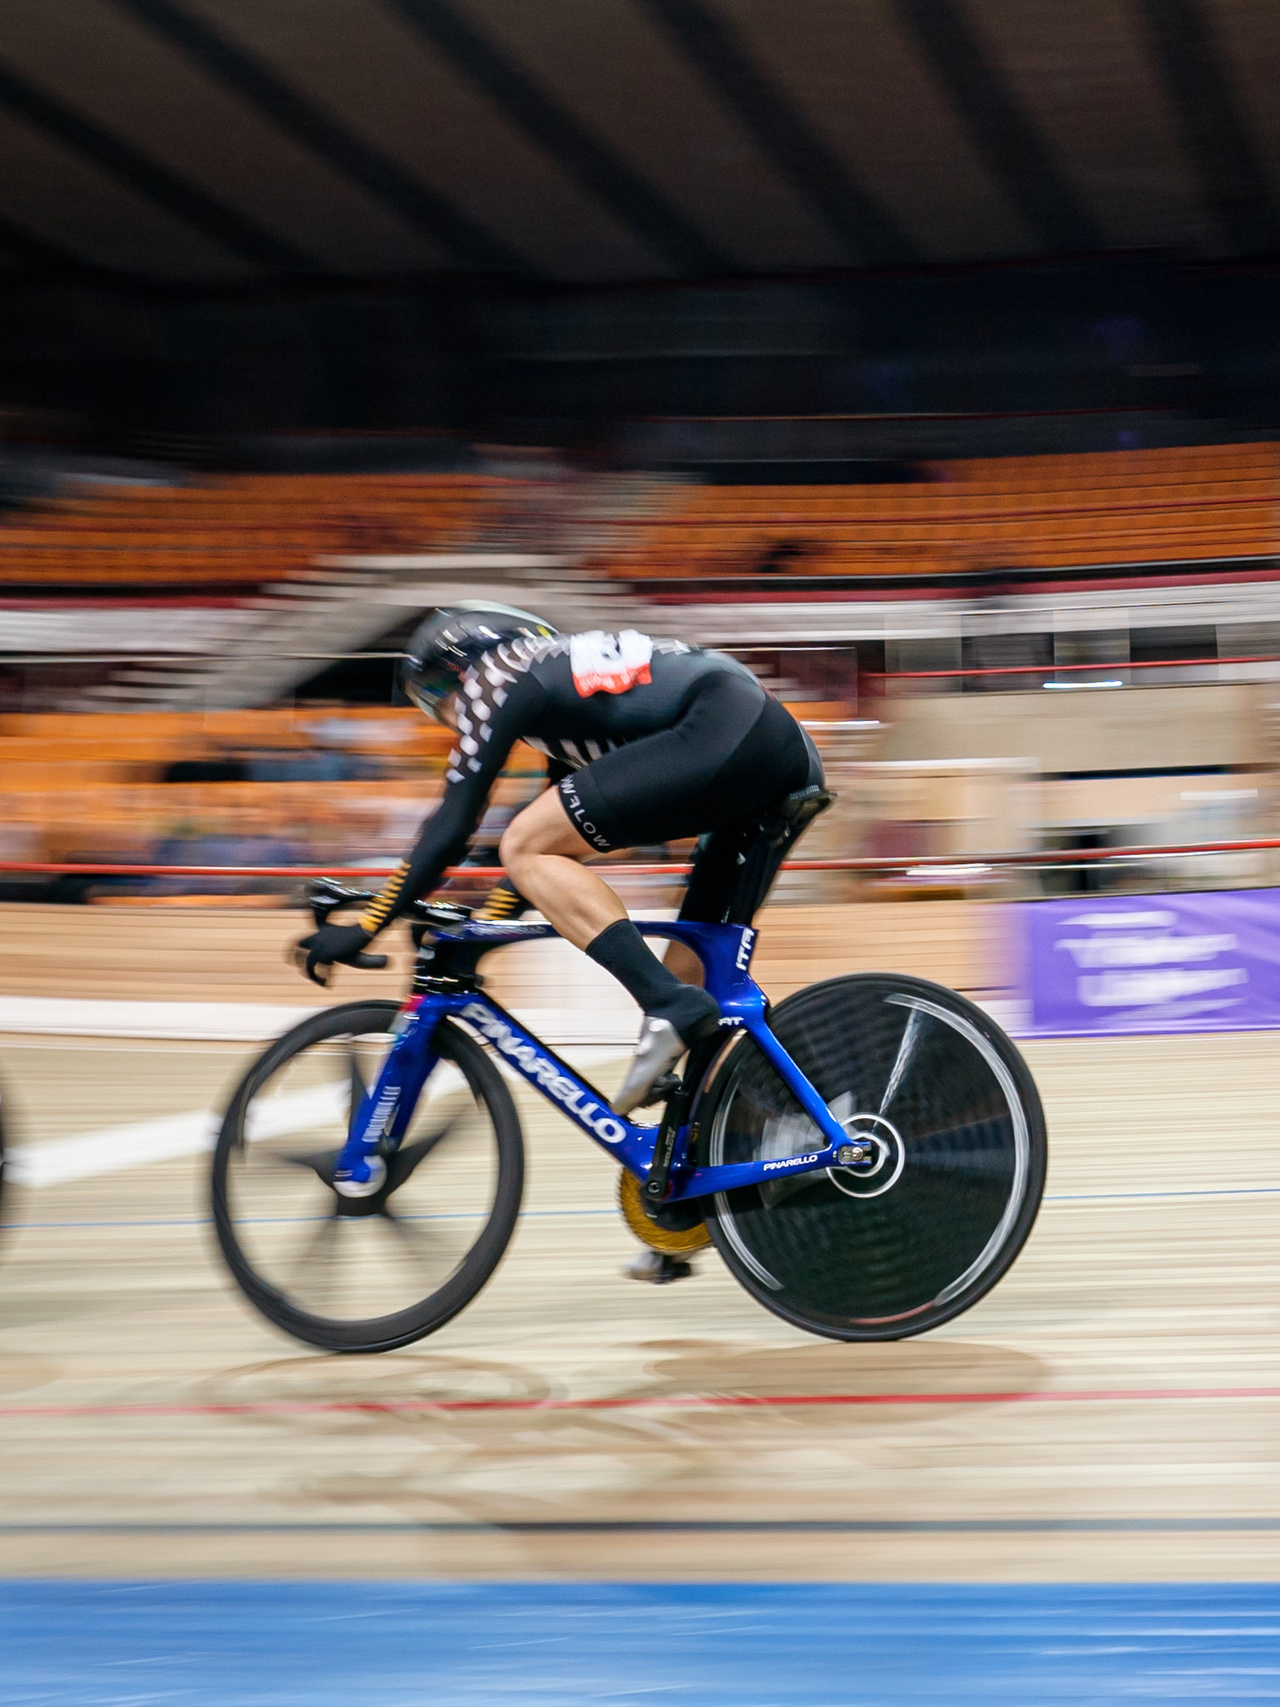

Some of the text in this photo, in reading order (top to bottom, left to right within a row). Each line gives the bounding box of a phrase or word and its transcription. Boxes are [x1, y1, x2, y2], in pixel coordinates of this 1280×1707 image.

[736, 927, 755, 971] ITA
[459, 1002, 627, 1144] PINARELLO
[762, 1154, 818, 1171] PINARELLO
